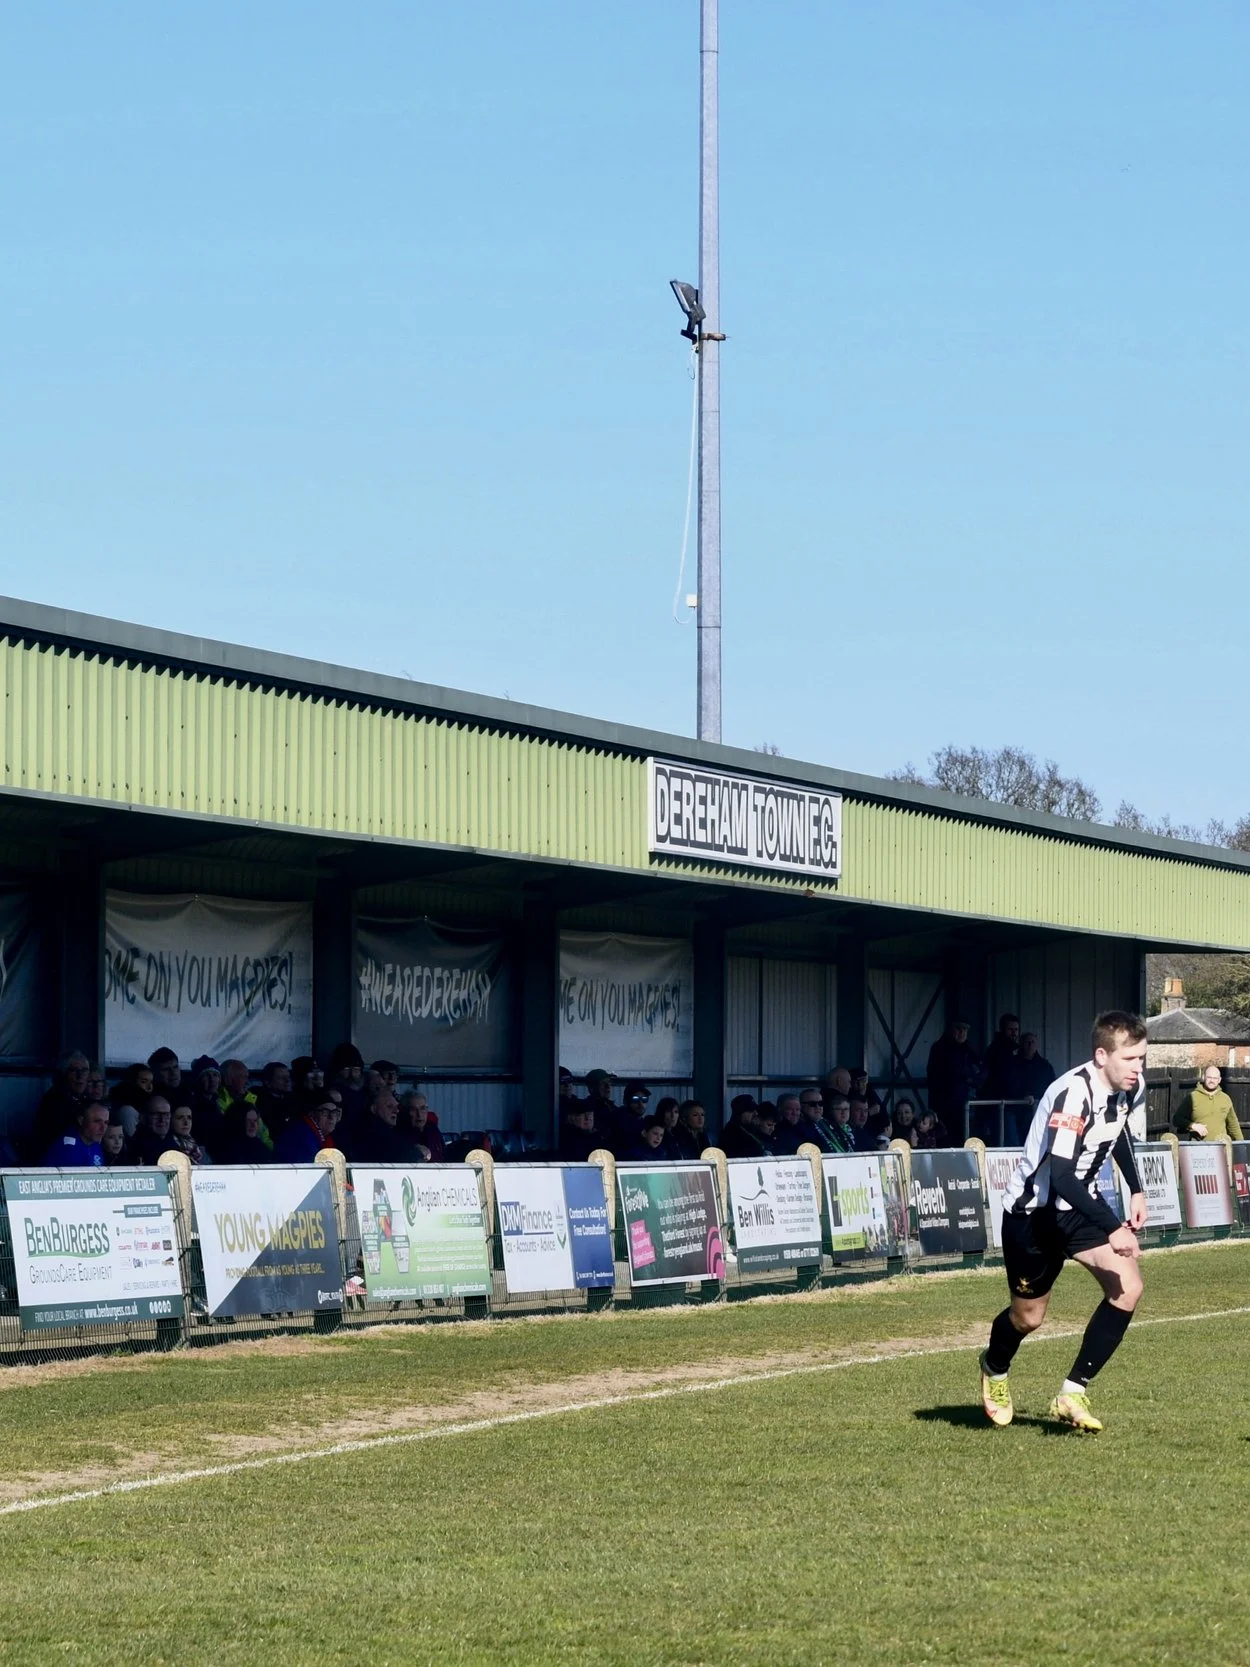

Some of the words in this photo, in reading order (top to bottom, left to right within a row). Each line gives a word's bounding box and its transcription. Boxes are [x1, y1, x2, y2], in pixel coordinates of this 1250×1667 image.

[656, 767, 748, 856] DEREHAM
[753, 786, 805, 864] TOWN
[808, 796, 837, 869] F.C.
[144, 951, 171, 1008] ON
[176, 951, 211, 1013] YOU
[217, 952, 293, 1016] MAGPIES!
[359, 957, 491, 1027] #WEAREDEREHAM
[578, 980, 598, 1026] ON
[601, 979, 625, 1030] YOU
[19, 1180, 31, 1194] EAST
[74, 1179, 96, 1193] GROUNDS
[98, 1179, 108, 1192] CARE
[109, 1178, 134, 1193] EQUIPMENT
[136, 1178, 155, 1190] RETAILER
[417, 1187, 441, 1212] Anglian
[442, 1188, 477, 1207] CHEMICALS
[914, 1177, 946, 1215] Reverb
[214, 1212, 265, 1253] YOUNG
[267, 1210, 325, 1250] MAGPIES
[501, 1205, 521, 1231] DKM
[521, 1209, 553, 1230] Finance
[738, 1205, 753, 1228] Ben
[753, 1203, 774, 1227] Willis
[85, 1302, 138, 1320] www.benburgess.co.uk
